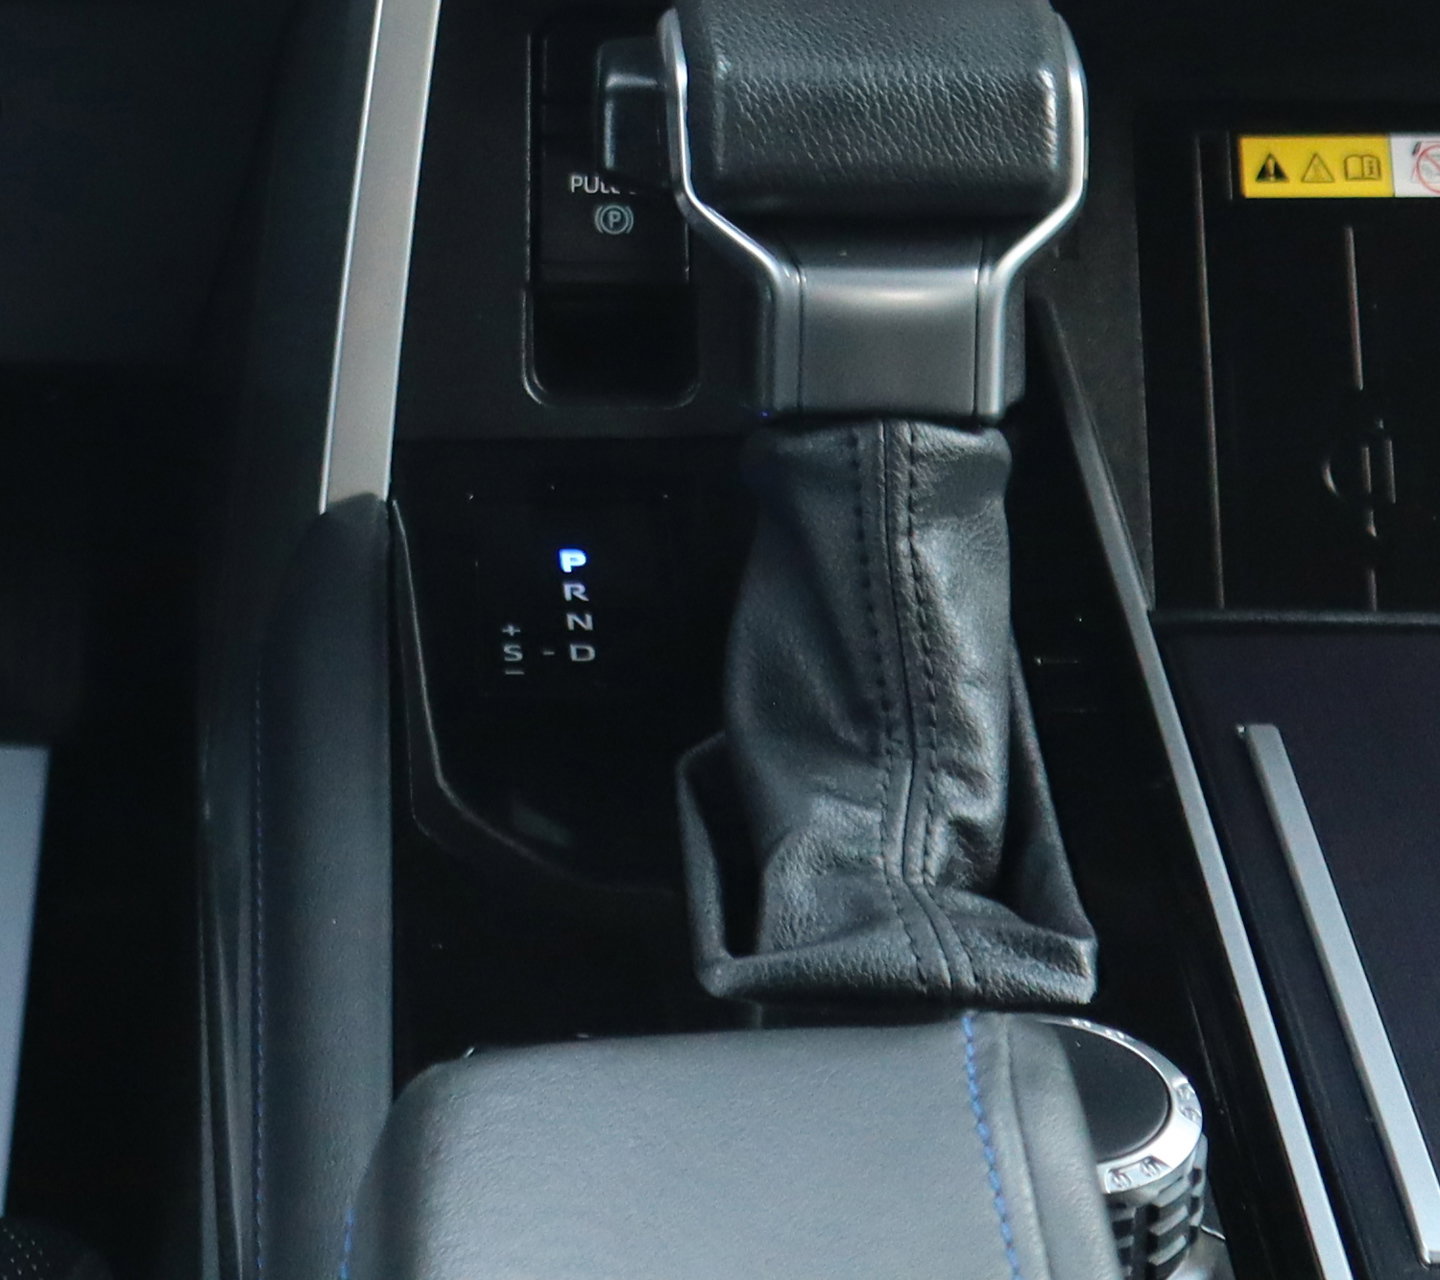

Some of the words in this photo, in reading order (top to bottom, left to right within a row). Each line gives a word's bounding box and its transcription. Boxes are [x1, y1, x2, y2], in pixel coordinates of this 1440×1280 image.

[557, 546, 590, 574] P
[561, 581, 591, 603] R
[566, 611, 594, 632] N
[503, 644, 525, 663] S
[568, 643, 597, 663] D
